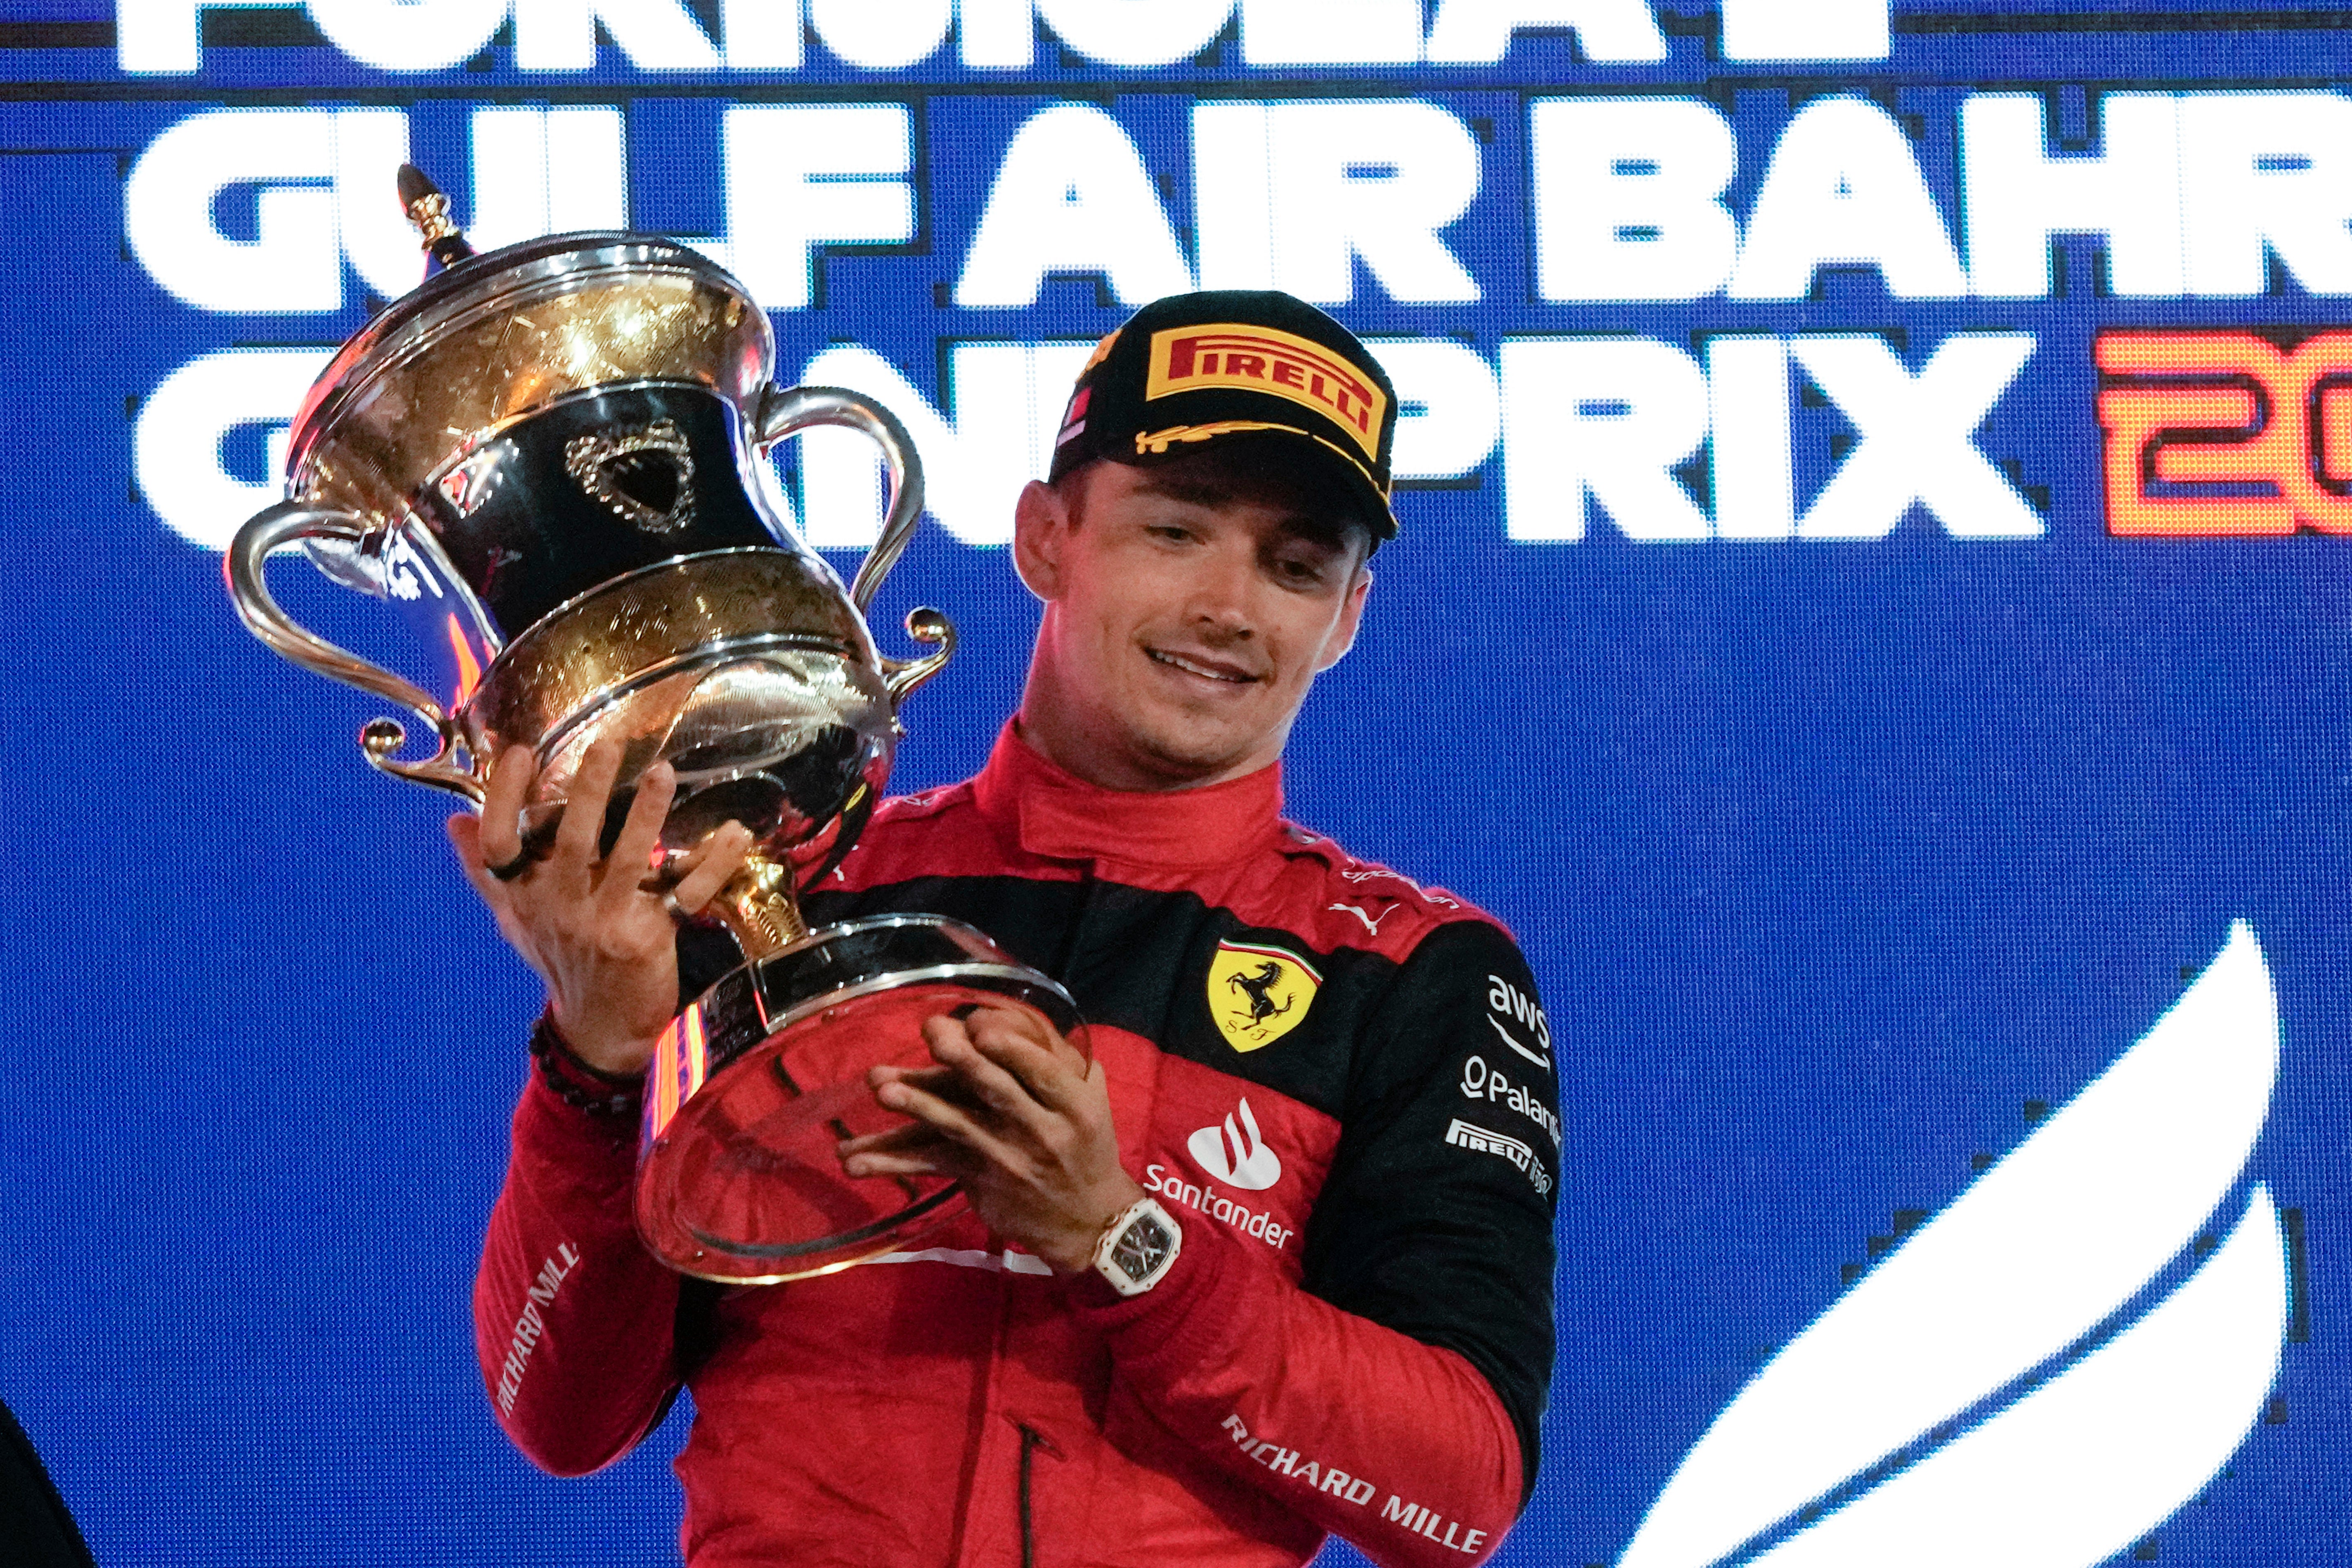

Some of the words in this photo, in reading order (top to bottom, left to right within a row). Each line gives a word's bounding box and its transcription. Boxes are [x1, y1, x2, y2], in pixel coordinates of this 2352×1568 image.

[951, 100, 1482, 309] AIR
[1169, 334, 1372, 435] PIRELLI
[1488, 974, 1550, 1048] aws
[1445, 1118, 1533, 1172] PIRELLI
[1143, 1164, 1294, 1249] Santander
[529, 1241, 580, 1307] MILL
[1221, 1414, 1376, 1505] RICHARD
[1381, 1495, 1487, 1554] MILLE
